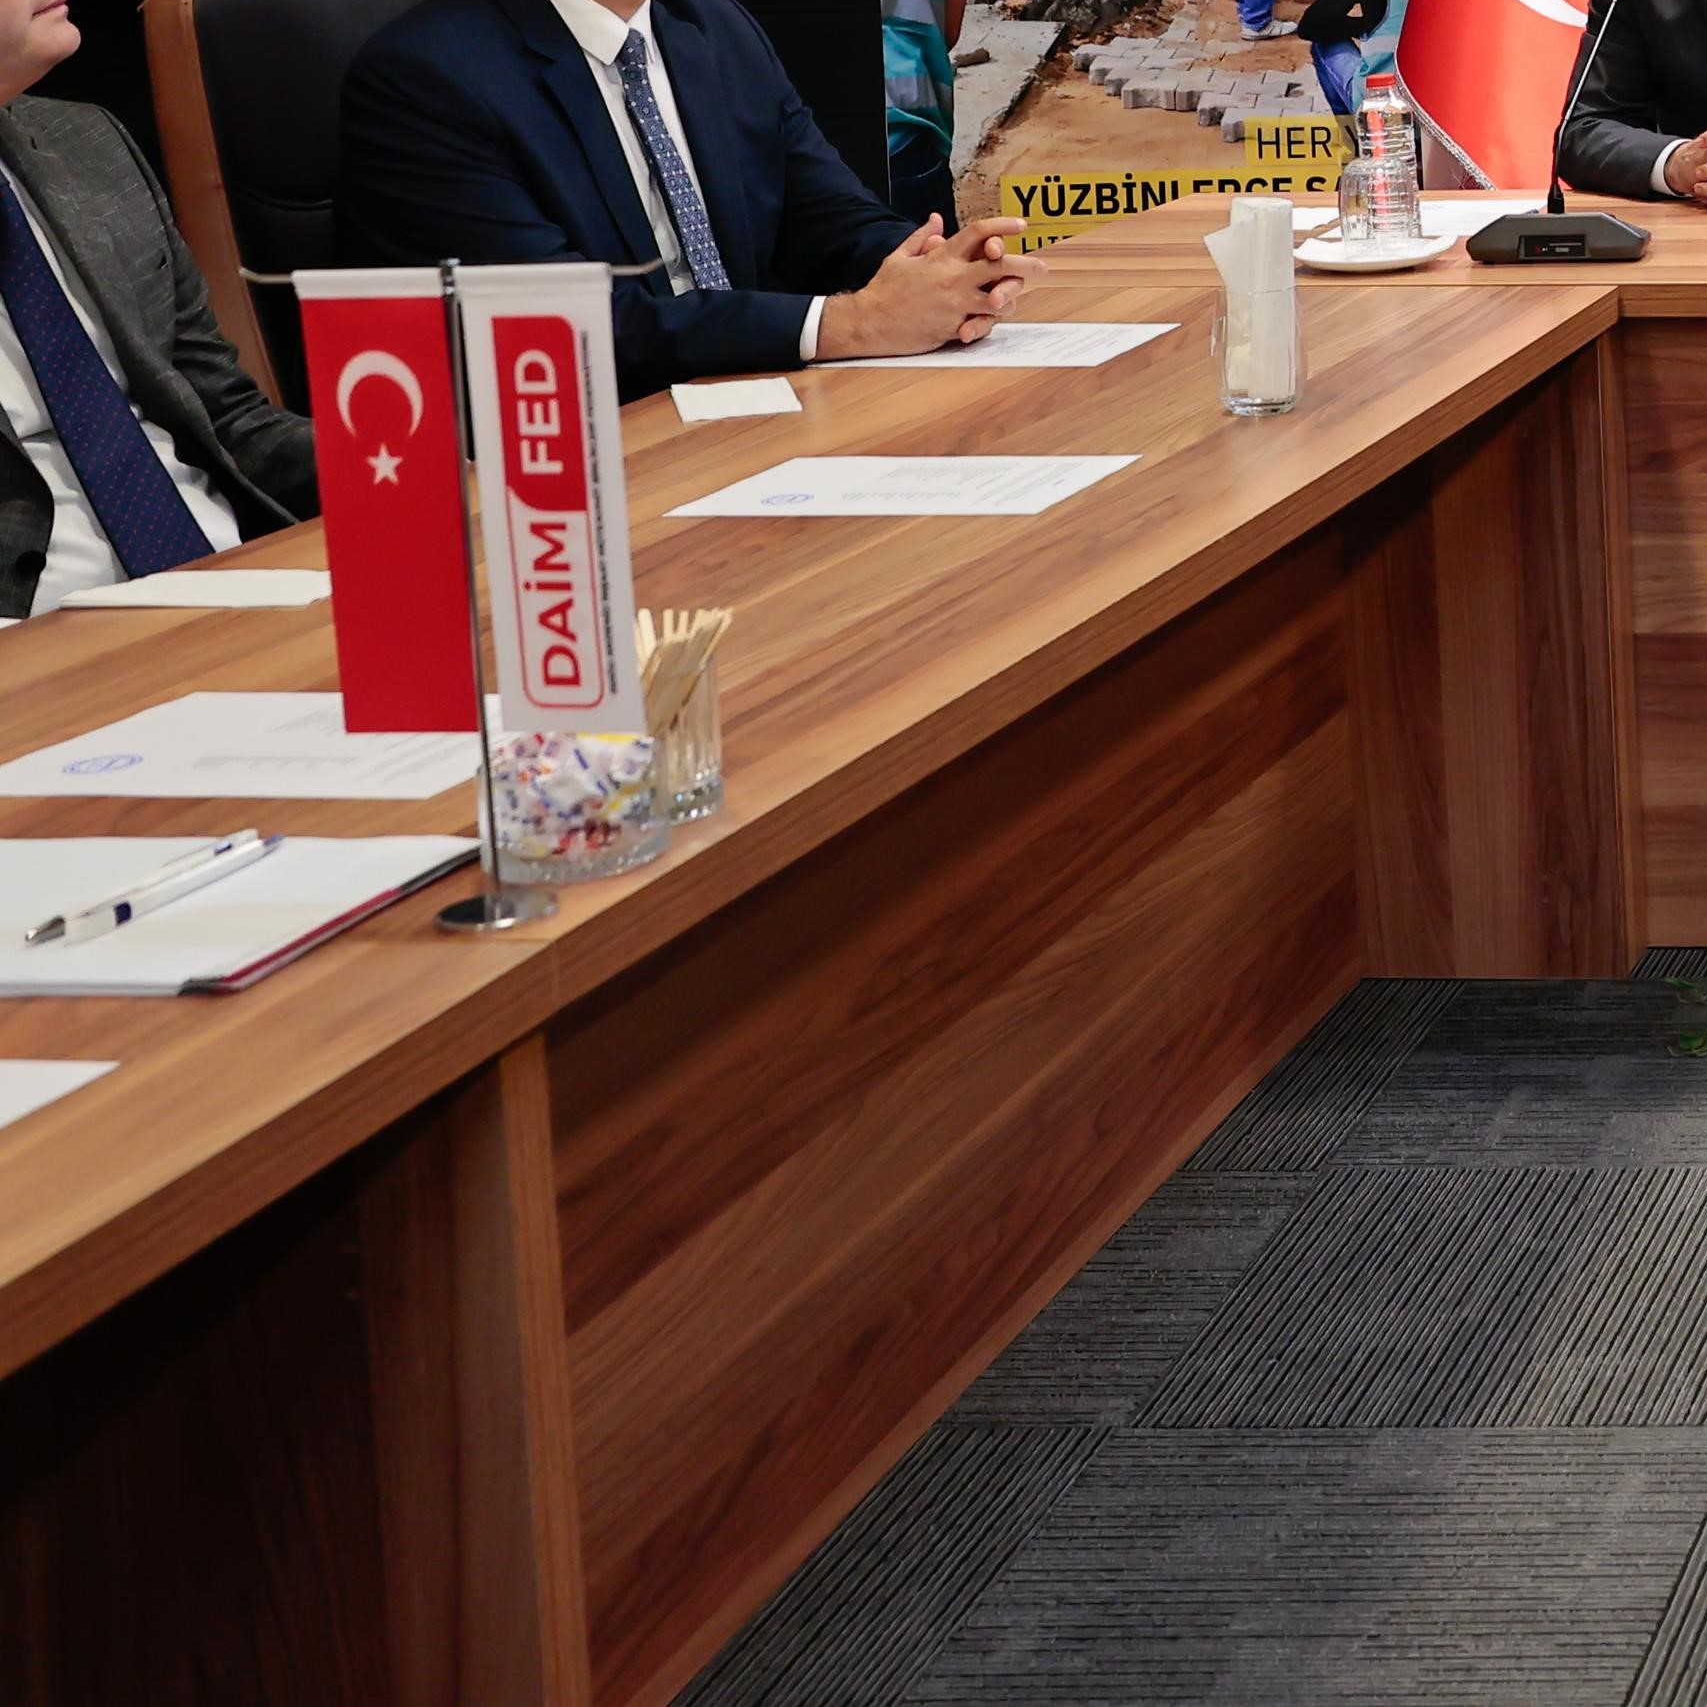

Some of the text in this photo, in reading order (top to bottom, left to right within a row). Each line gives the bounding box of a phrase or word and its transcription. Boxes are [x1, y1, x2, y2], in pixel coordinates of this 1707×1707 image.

[1256, 126, 1333, 160] HER
[1011, 172, 1293, 219] YÜZBİN
[513, 348, 583, 688] DAİM FED
